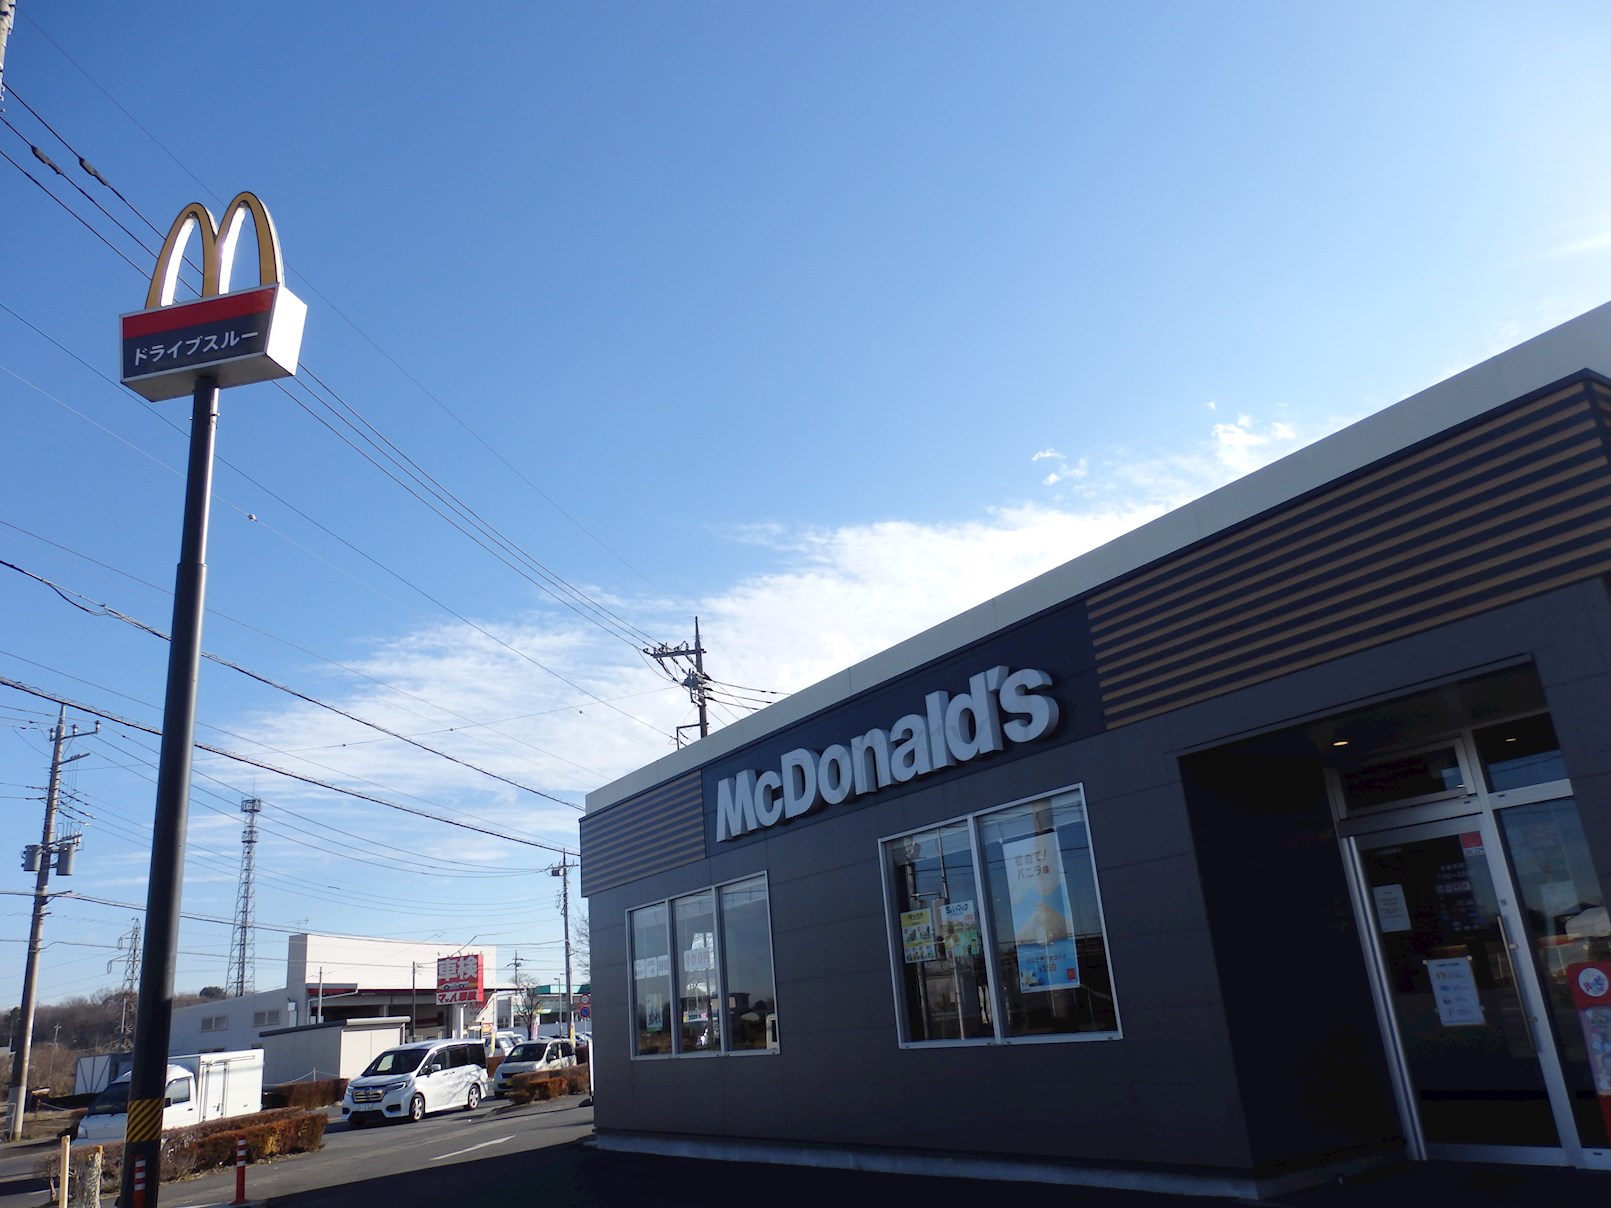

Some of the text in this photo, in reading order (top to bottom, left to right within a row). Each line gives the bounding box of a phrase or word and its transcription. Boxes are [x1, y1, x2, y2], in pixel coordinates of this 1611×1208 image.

[134, 329, 259, 367] ドライブスルー
[715, 665, 1060, 844] McDonald's
[438, 957, 478, 981] 車検
